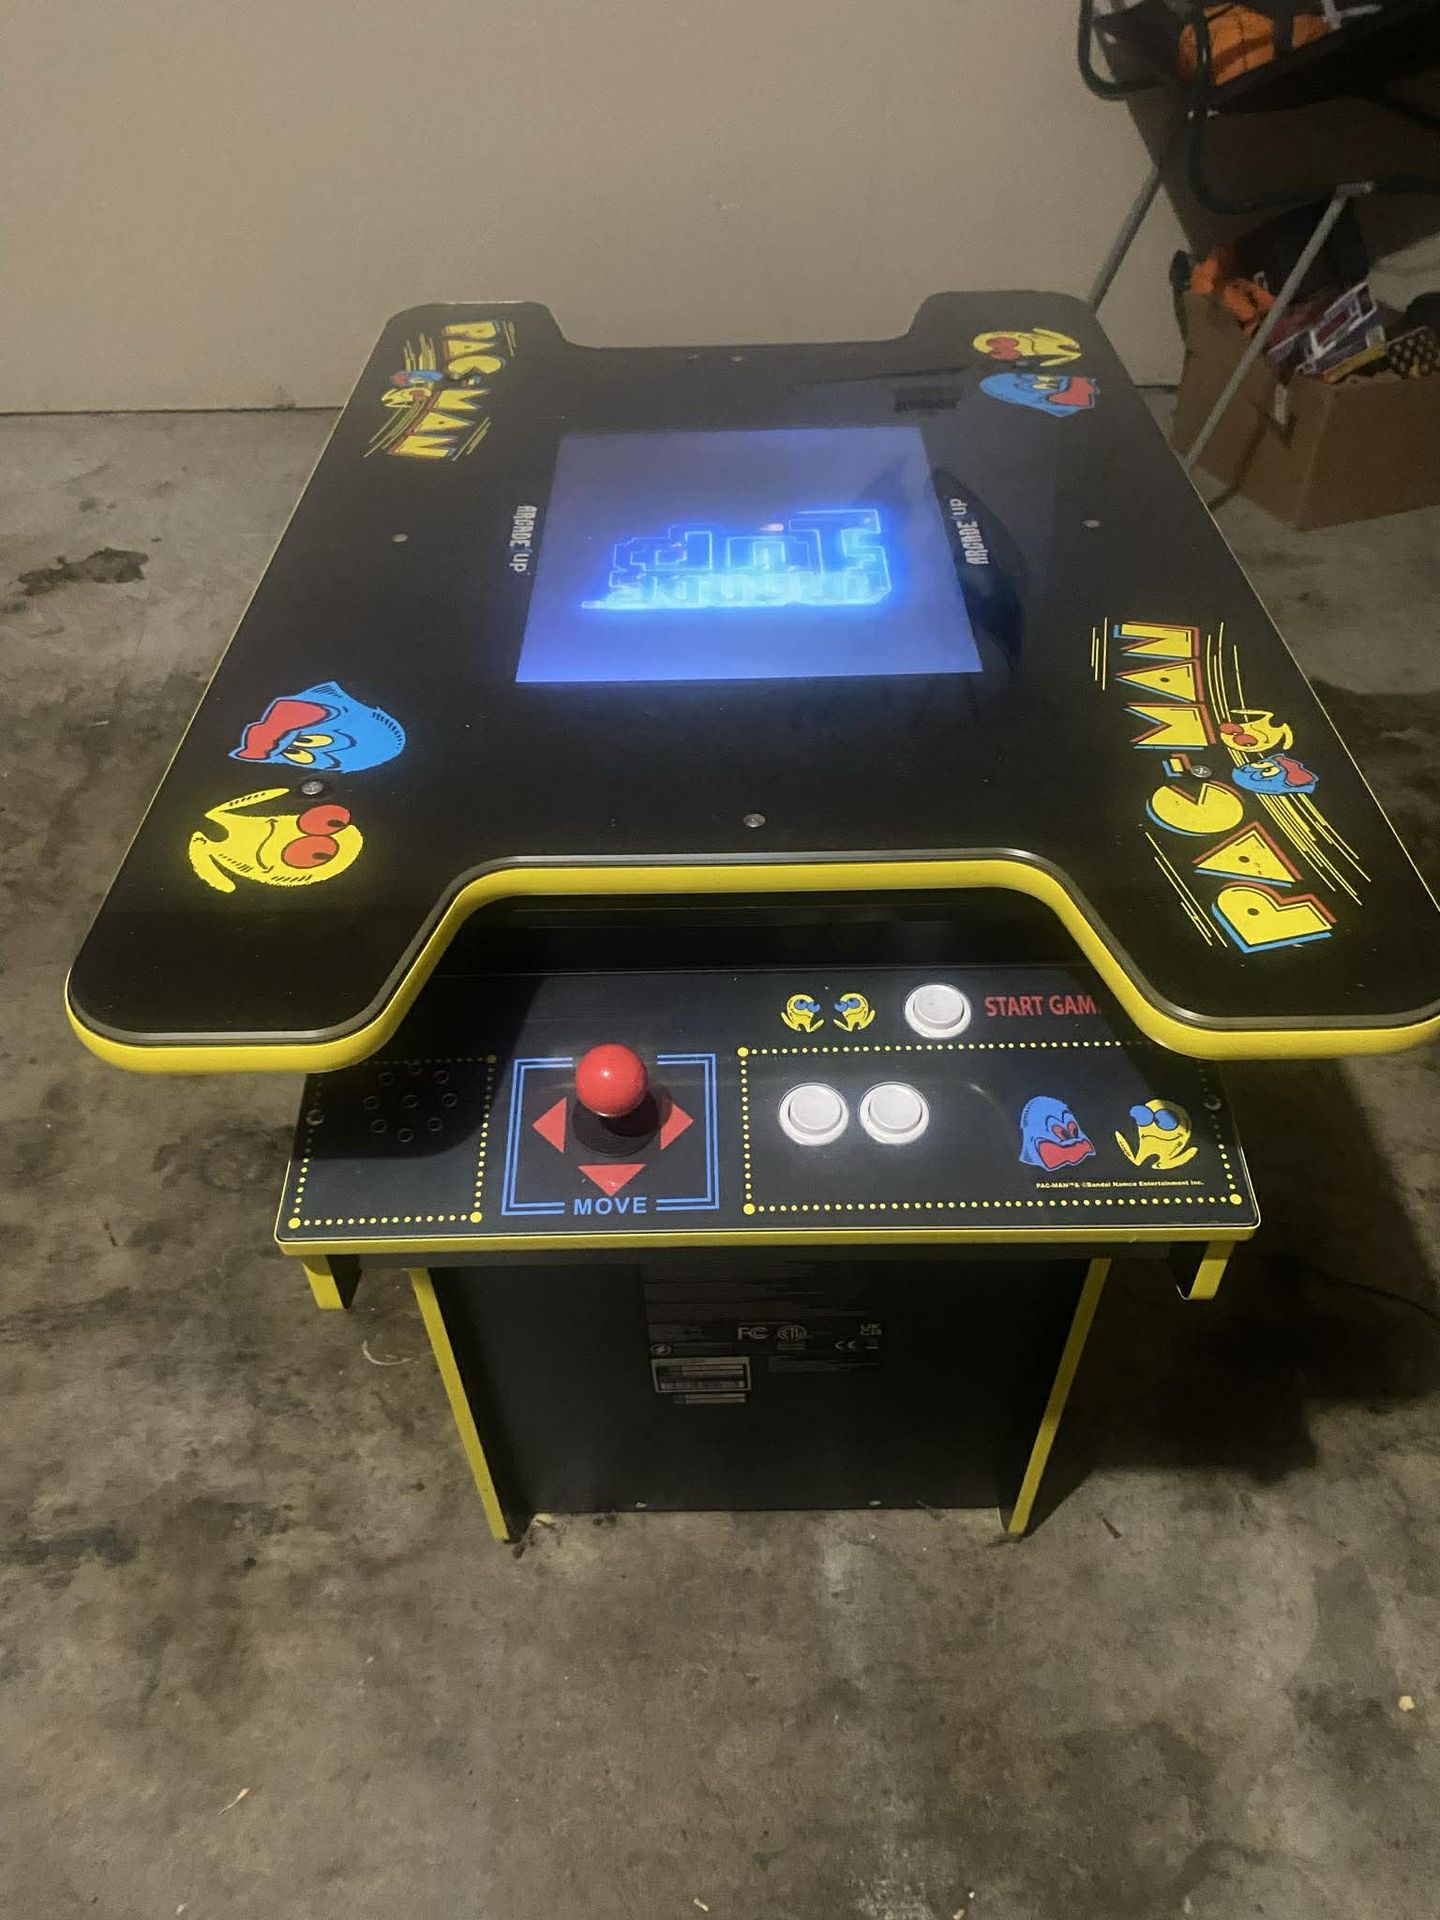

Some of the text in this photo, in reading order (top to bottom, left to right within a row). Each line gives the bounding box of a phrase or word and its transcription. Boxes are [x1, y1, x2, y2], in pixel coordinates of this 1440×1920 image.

[984, 994, 1102, 1017] START GAM
[573, 1196, 648, 1215] MOVE
